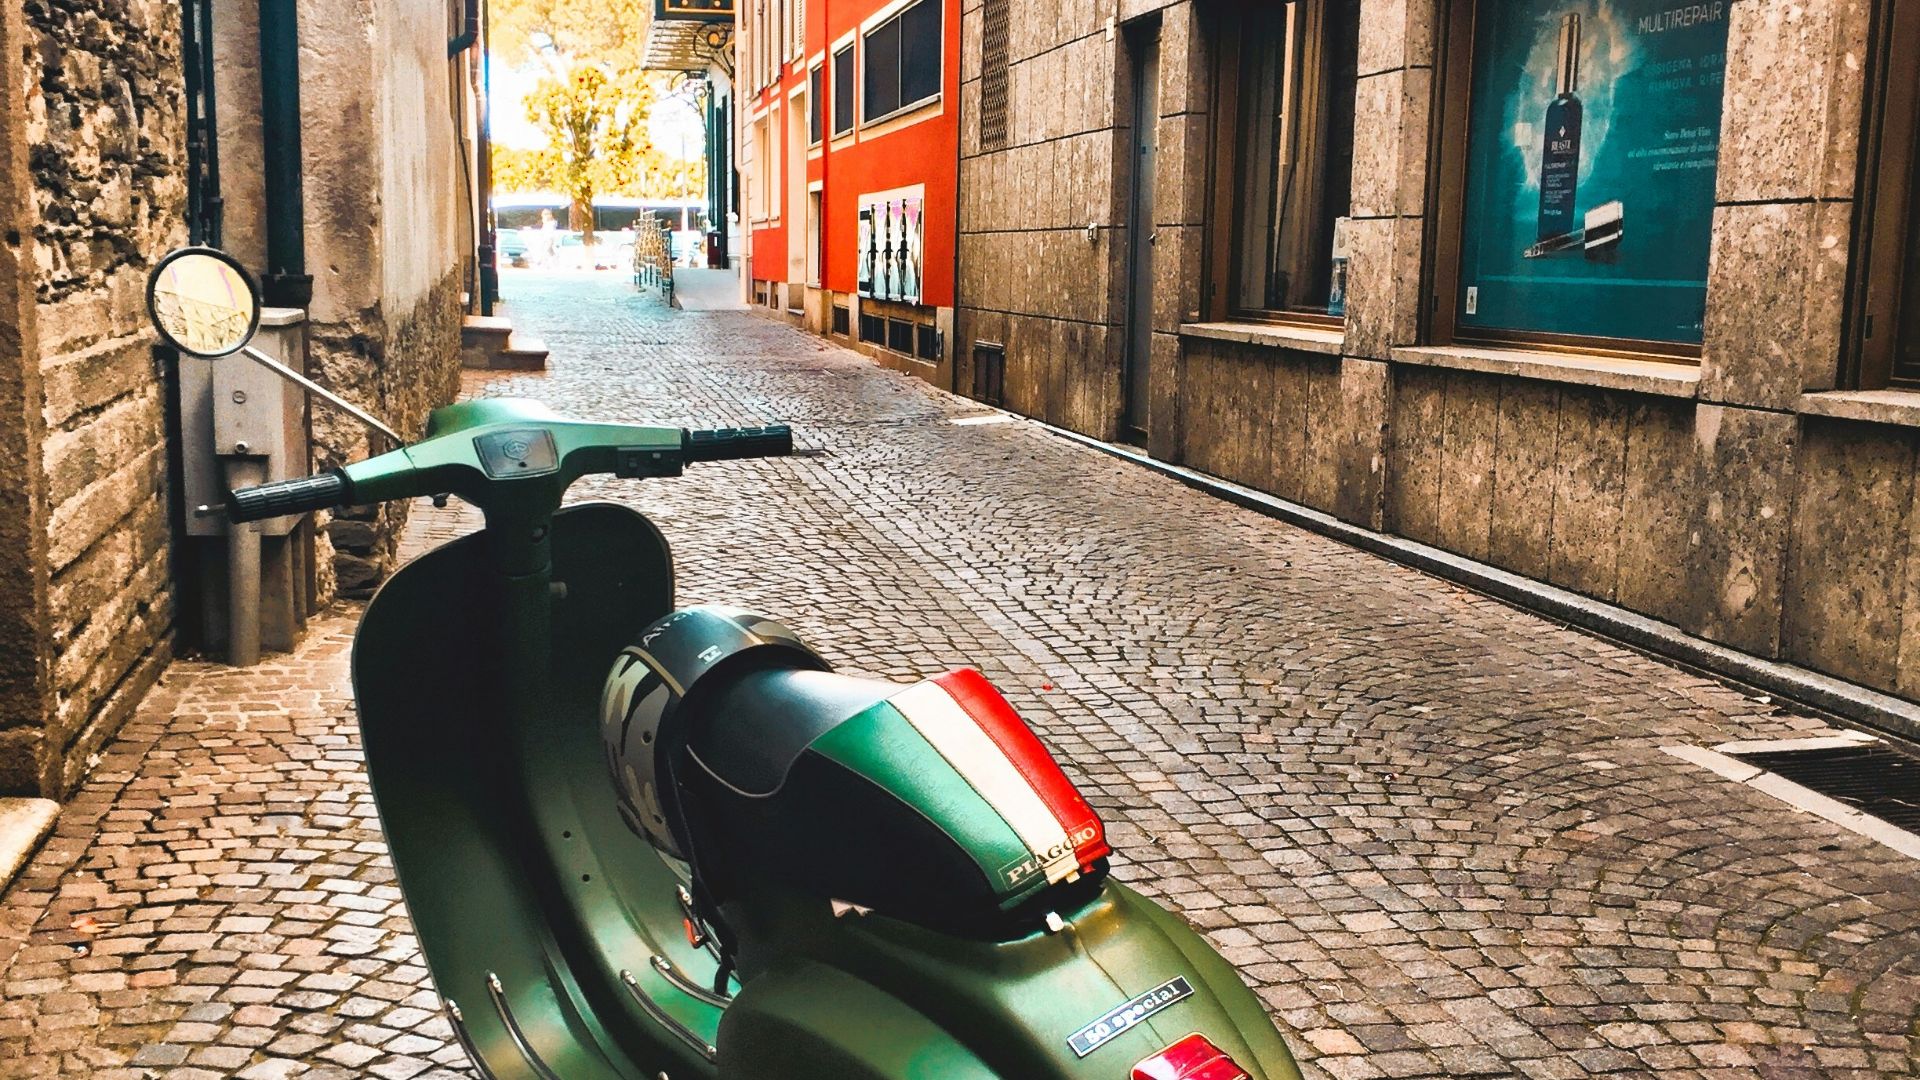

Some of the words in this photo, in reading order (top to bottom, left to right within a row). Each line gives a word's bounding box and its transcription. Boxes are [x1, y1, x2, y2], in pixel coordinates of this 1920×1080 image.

[1638, 1, 1723, 34] MULTIREPAIR
[1007, 827, 1096, 884] PIAGGIO
[1084, 1022, 1111, 1045] 50
[1111, 983, 1181, 1029] special
